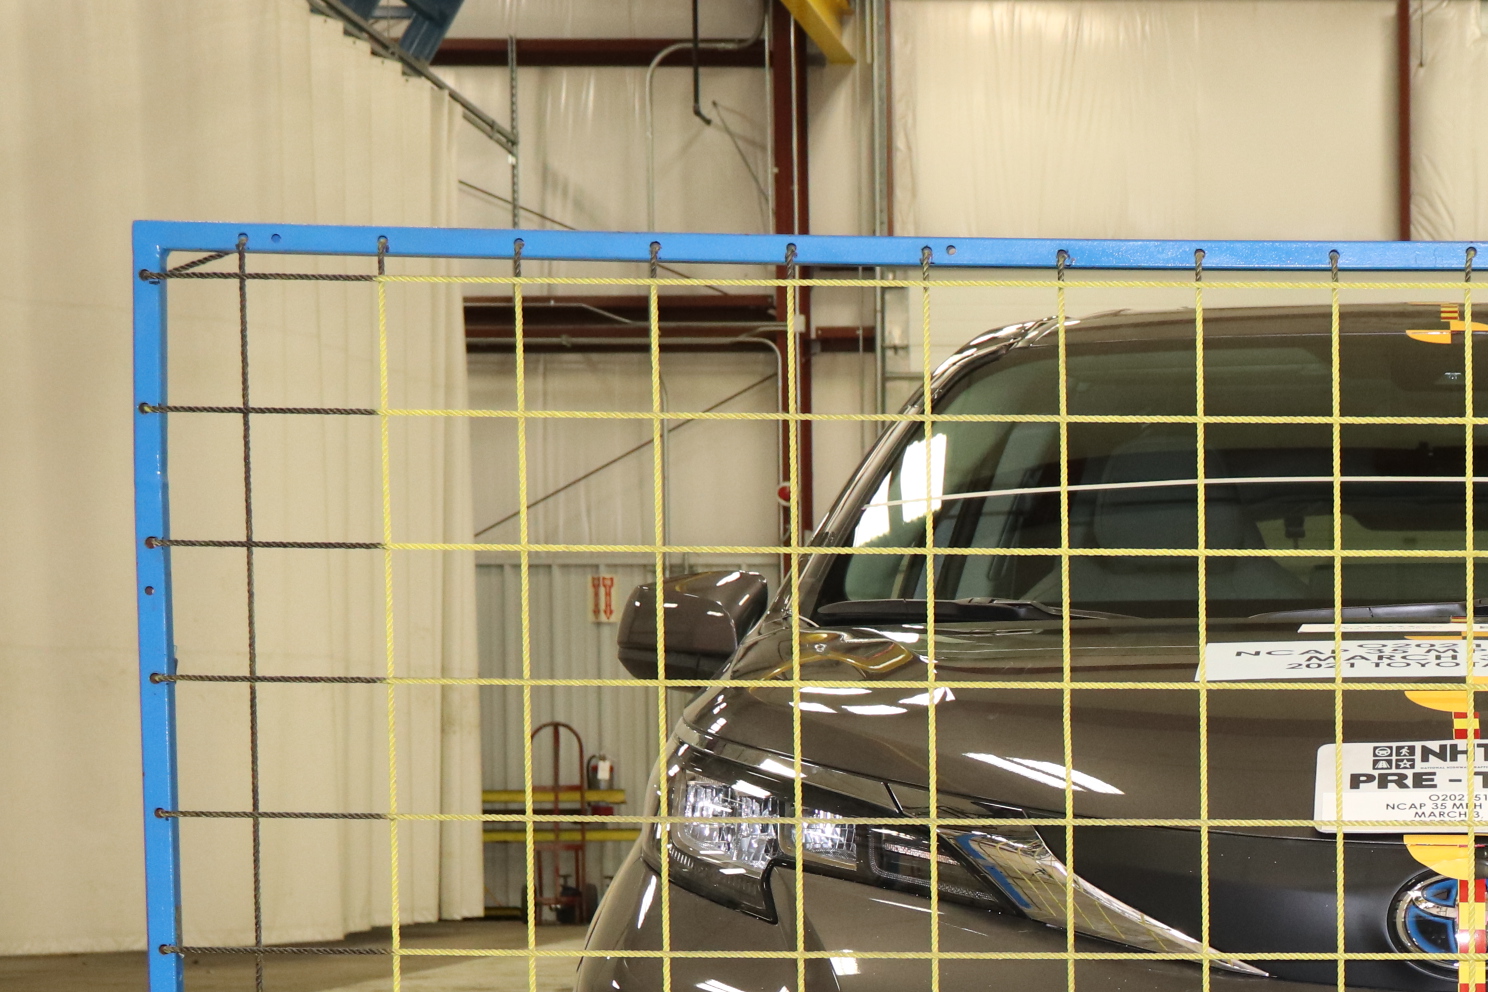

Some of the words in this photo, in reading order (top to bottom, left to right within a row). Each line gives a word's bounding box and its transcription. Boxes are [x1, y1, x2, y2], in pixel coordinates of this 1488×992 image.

[1305, 654, 1459, 662] MARCH
[1286, 662, 1356, 670] 2021
[1349, 771, 1438, 790] PRE
[1385, 802, 1427, 811] NCAP
[1431, 802, 1448, 811] 35
[1413, 810, 1468, 819] MARCH
[1473, 810, 1484, 820] 3,
